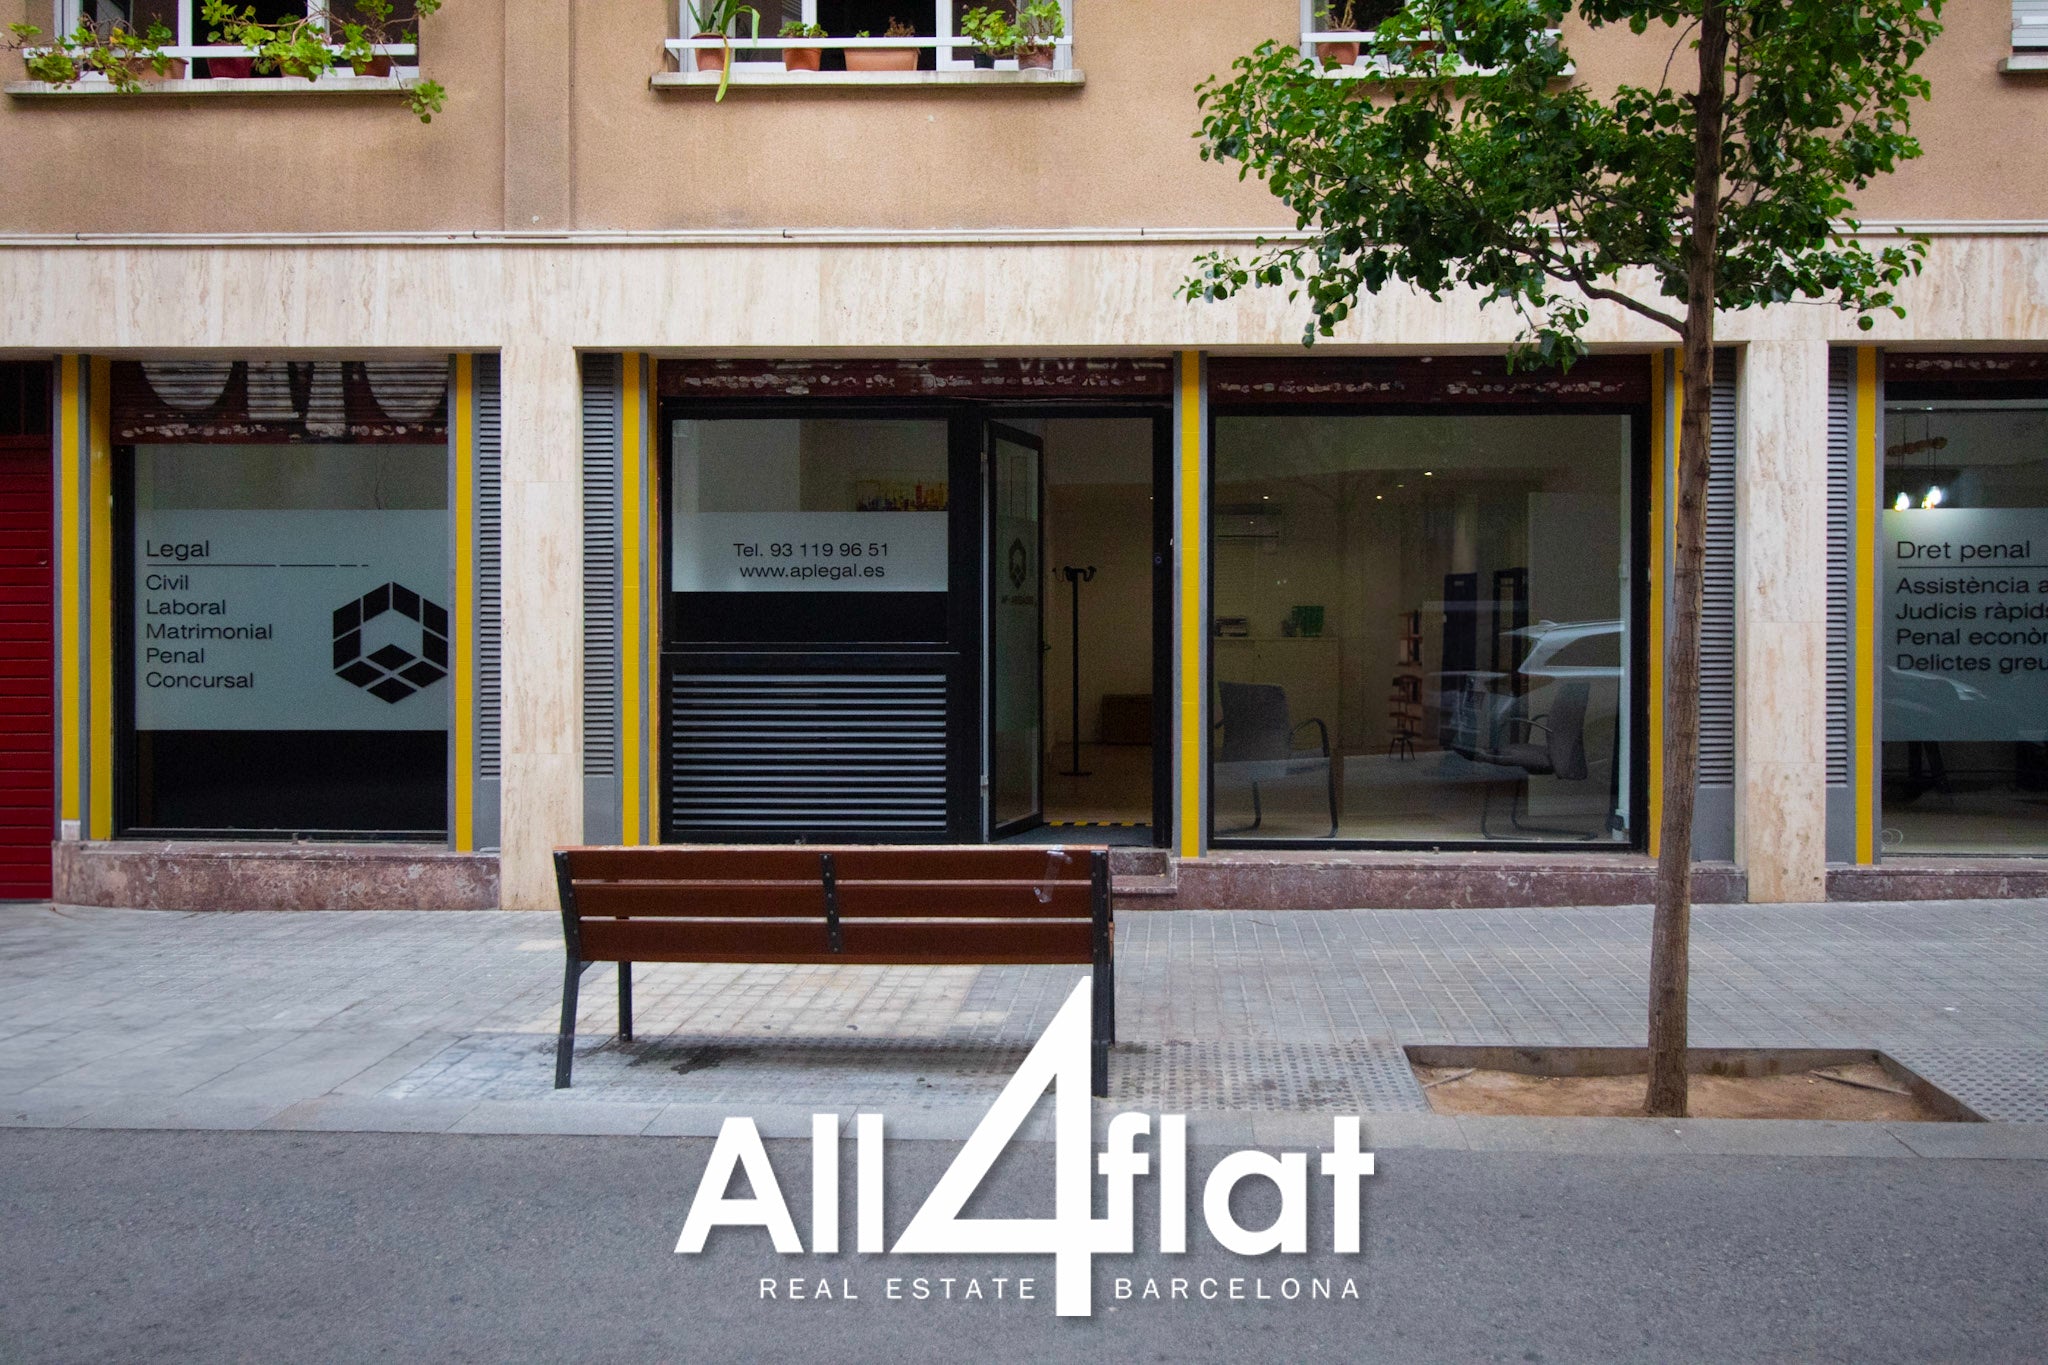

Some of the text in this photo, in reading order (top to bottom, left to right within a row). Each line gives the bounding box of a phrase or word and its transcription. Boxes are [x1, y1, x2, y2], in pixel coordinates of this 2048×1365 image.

[146, 539, 210, 561] Legal
[733, 543, 888, 558] Tel. 93 119 96 51
[1897, 540, 2031, 562] Dret penal
[739, 563, 885, 580] www.aplegal.es
[145, 573, 189, 591] Civil
[1896, 576, 2030, 595] Assistència
[146, 599, 226, 616] Laboral
[1895, 602, 1977, 621] Judicis
[146, 623, 273, 641] Matrimonial
[1897, 627, 1960, 646] Penal
[146, 647, 205, 664] Penal
[1896, 653, 1991, 672] Delictes
[145, 671, 254, 689] Concursal
